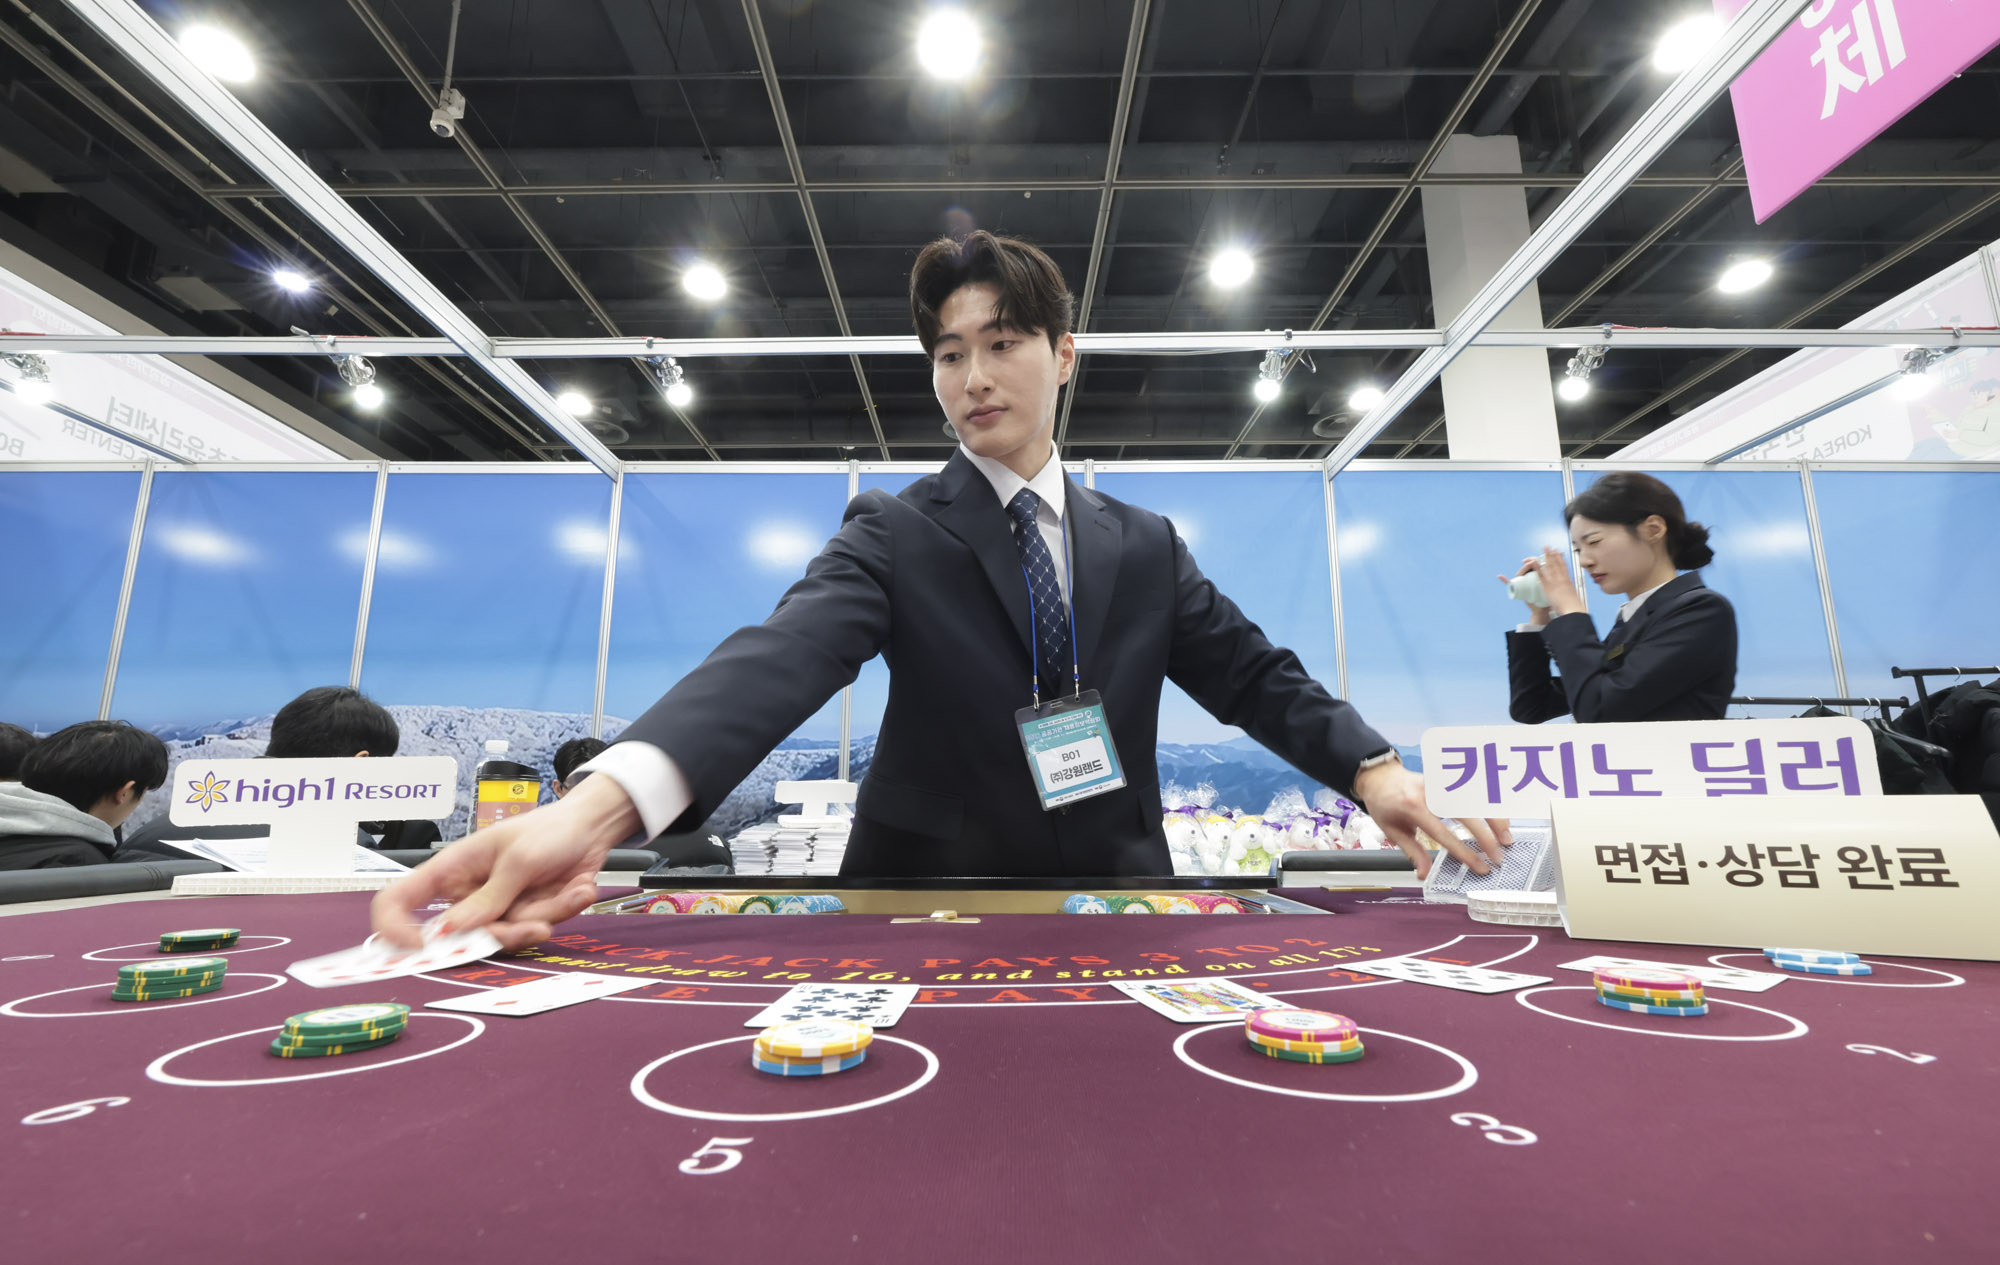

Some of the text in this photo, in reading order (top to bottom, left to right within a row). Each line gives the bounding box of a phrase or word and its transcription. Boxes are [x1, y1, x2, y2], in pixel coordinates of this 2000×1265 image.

[1810, 0, 1907, 120] 체
[1061, 749, 1080, 762] B01
[1441, 736, 1863, 804] 카지노 딜러
[1050, 759, 1103, 784] (주)강원랜드
[235, 777, 442, 808] high1 RESORT
[1593, 842, 1961, 891] 면접·상담 완료
[533, 956, 630, 969] must
[624, 964, 748, 978] draw
[762, 971, 812, 979] to
[936, 969, 1033, 980] and
[1055, 963, 1190, 979] stand
[1205, 960, 1256, 971] on
[1268, 953, 1320, 967] all
[547, 934, 692, 961] BLACK
[692, 954, 885, 968] JACK
[919, 955, 1110, 969] PAYS
[1139, 952, 1181, 962] 3
[1195, 944, 1280, 958] TO
[1284, 938, 1329, 947] 2
[1328, 970, 1377, 982] 2
[1845, 1042, 1938, 1065] 2
[20, 1095, 132, 1126] 6
[1450, 1111, 1539, 1146] 3
[678, 1136, 755, 1176] 5
